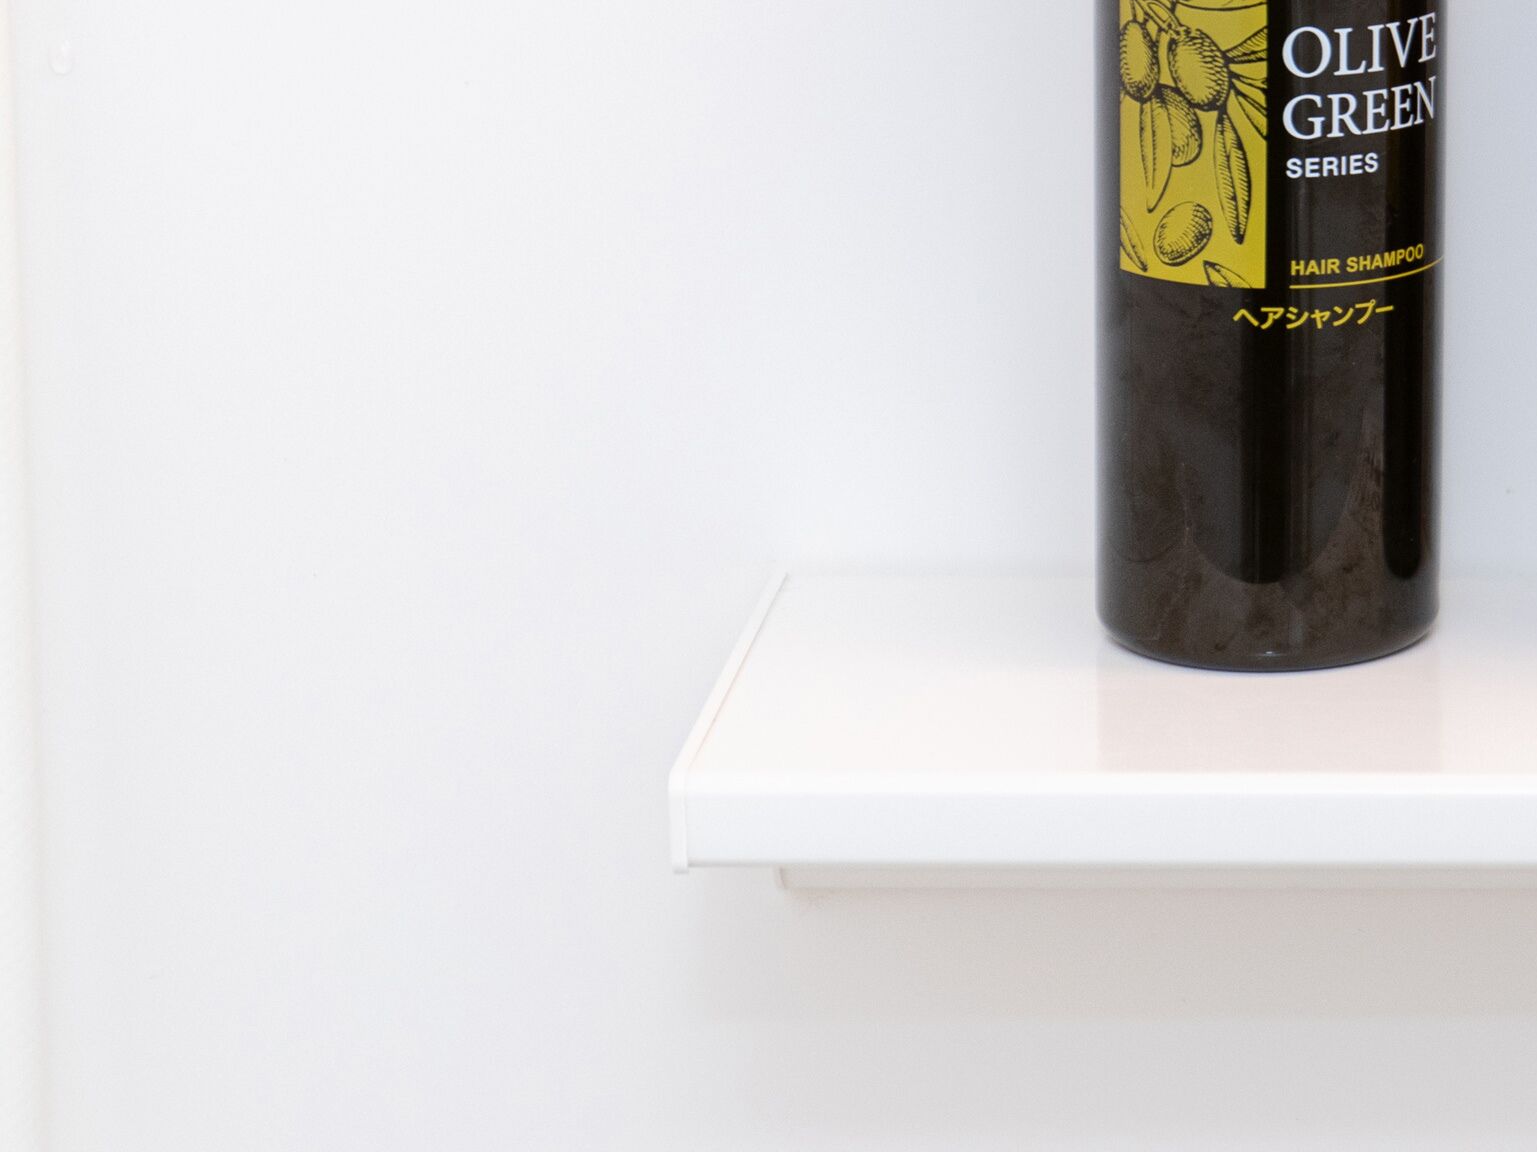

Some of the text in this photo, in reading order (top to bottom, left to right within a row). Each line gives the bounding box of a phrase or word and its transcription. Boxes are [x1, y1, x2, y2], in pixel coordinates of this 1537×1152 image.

[1282, 12, 1436, 78] OLIVE
[1282, 76, 1436, 140] GREEN
[1286, 152, 1379, 179] SERIES
[1291, 243, 1424, 276] HAIR SHAMPOO
[1233, 299, 1394, 330] ヘアシャンプー
